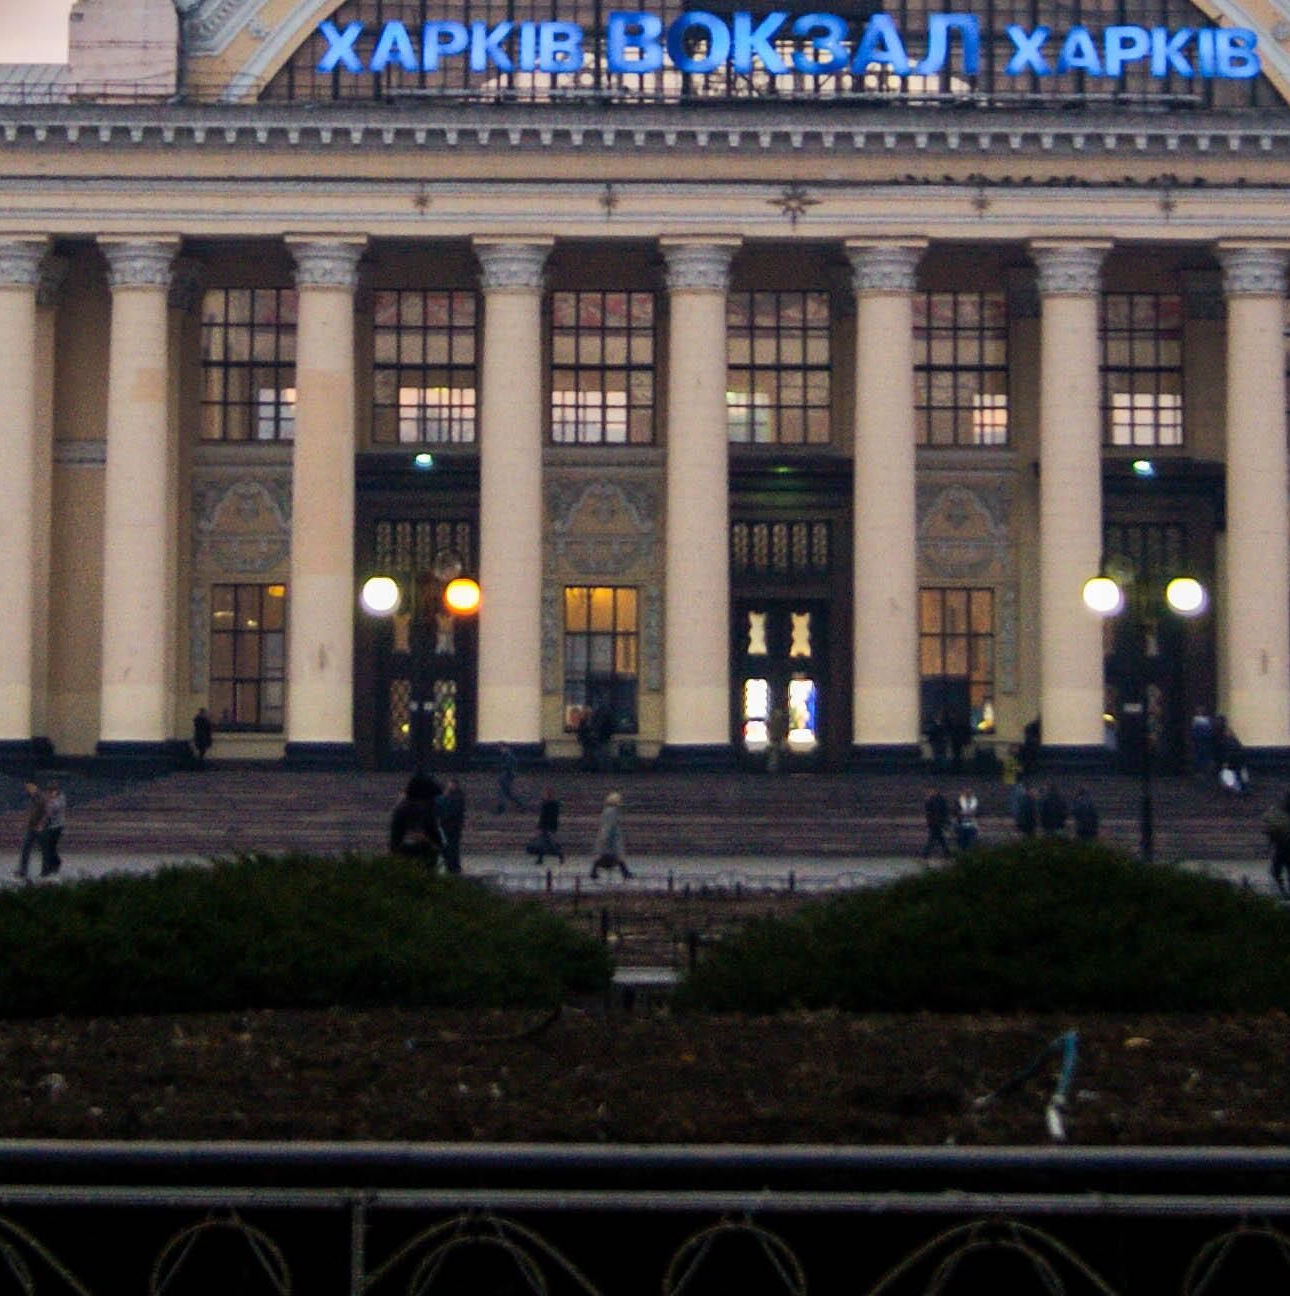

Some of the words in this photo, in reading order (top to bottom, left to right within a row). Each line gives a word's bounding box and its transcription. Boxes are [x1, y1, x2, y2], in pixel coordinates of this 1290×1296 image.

[315, 19, 584, 74] ХАРКІВ
[607, 9, 982, 76] ВОКЗАЛ
[1004, 23, 1263, 79] ХАРКІВ
